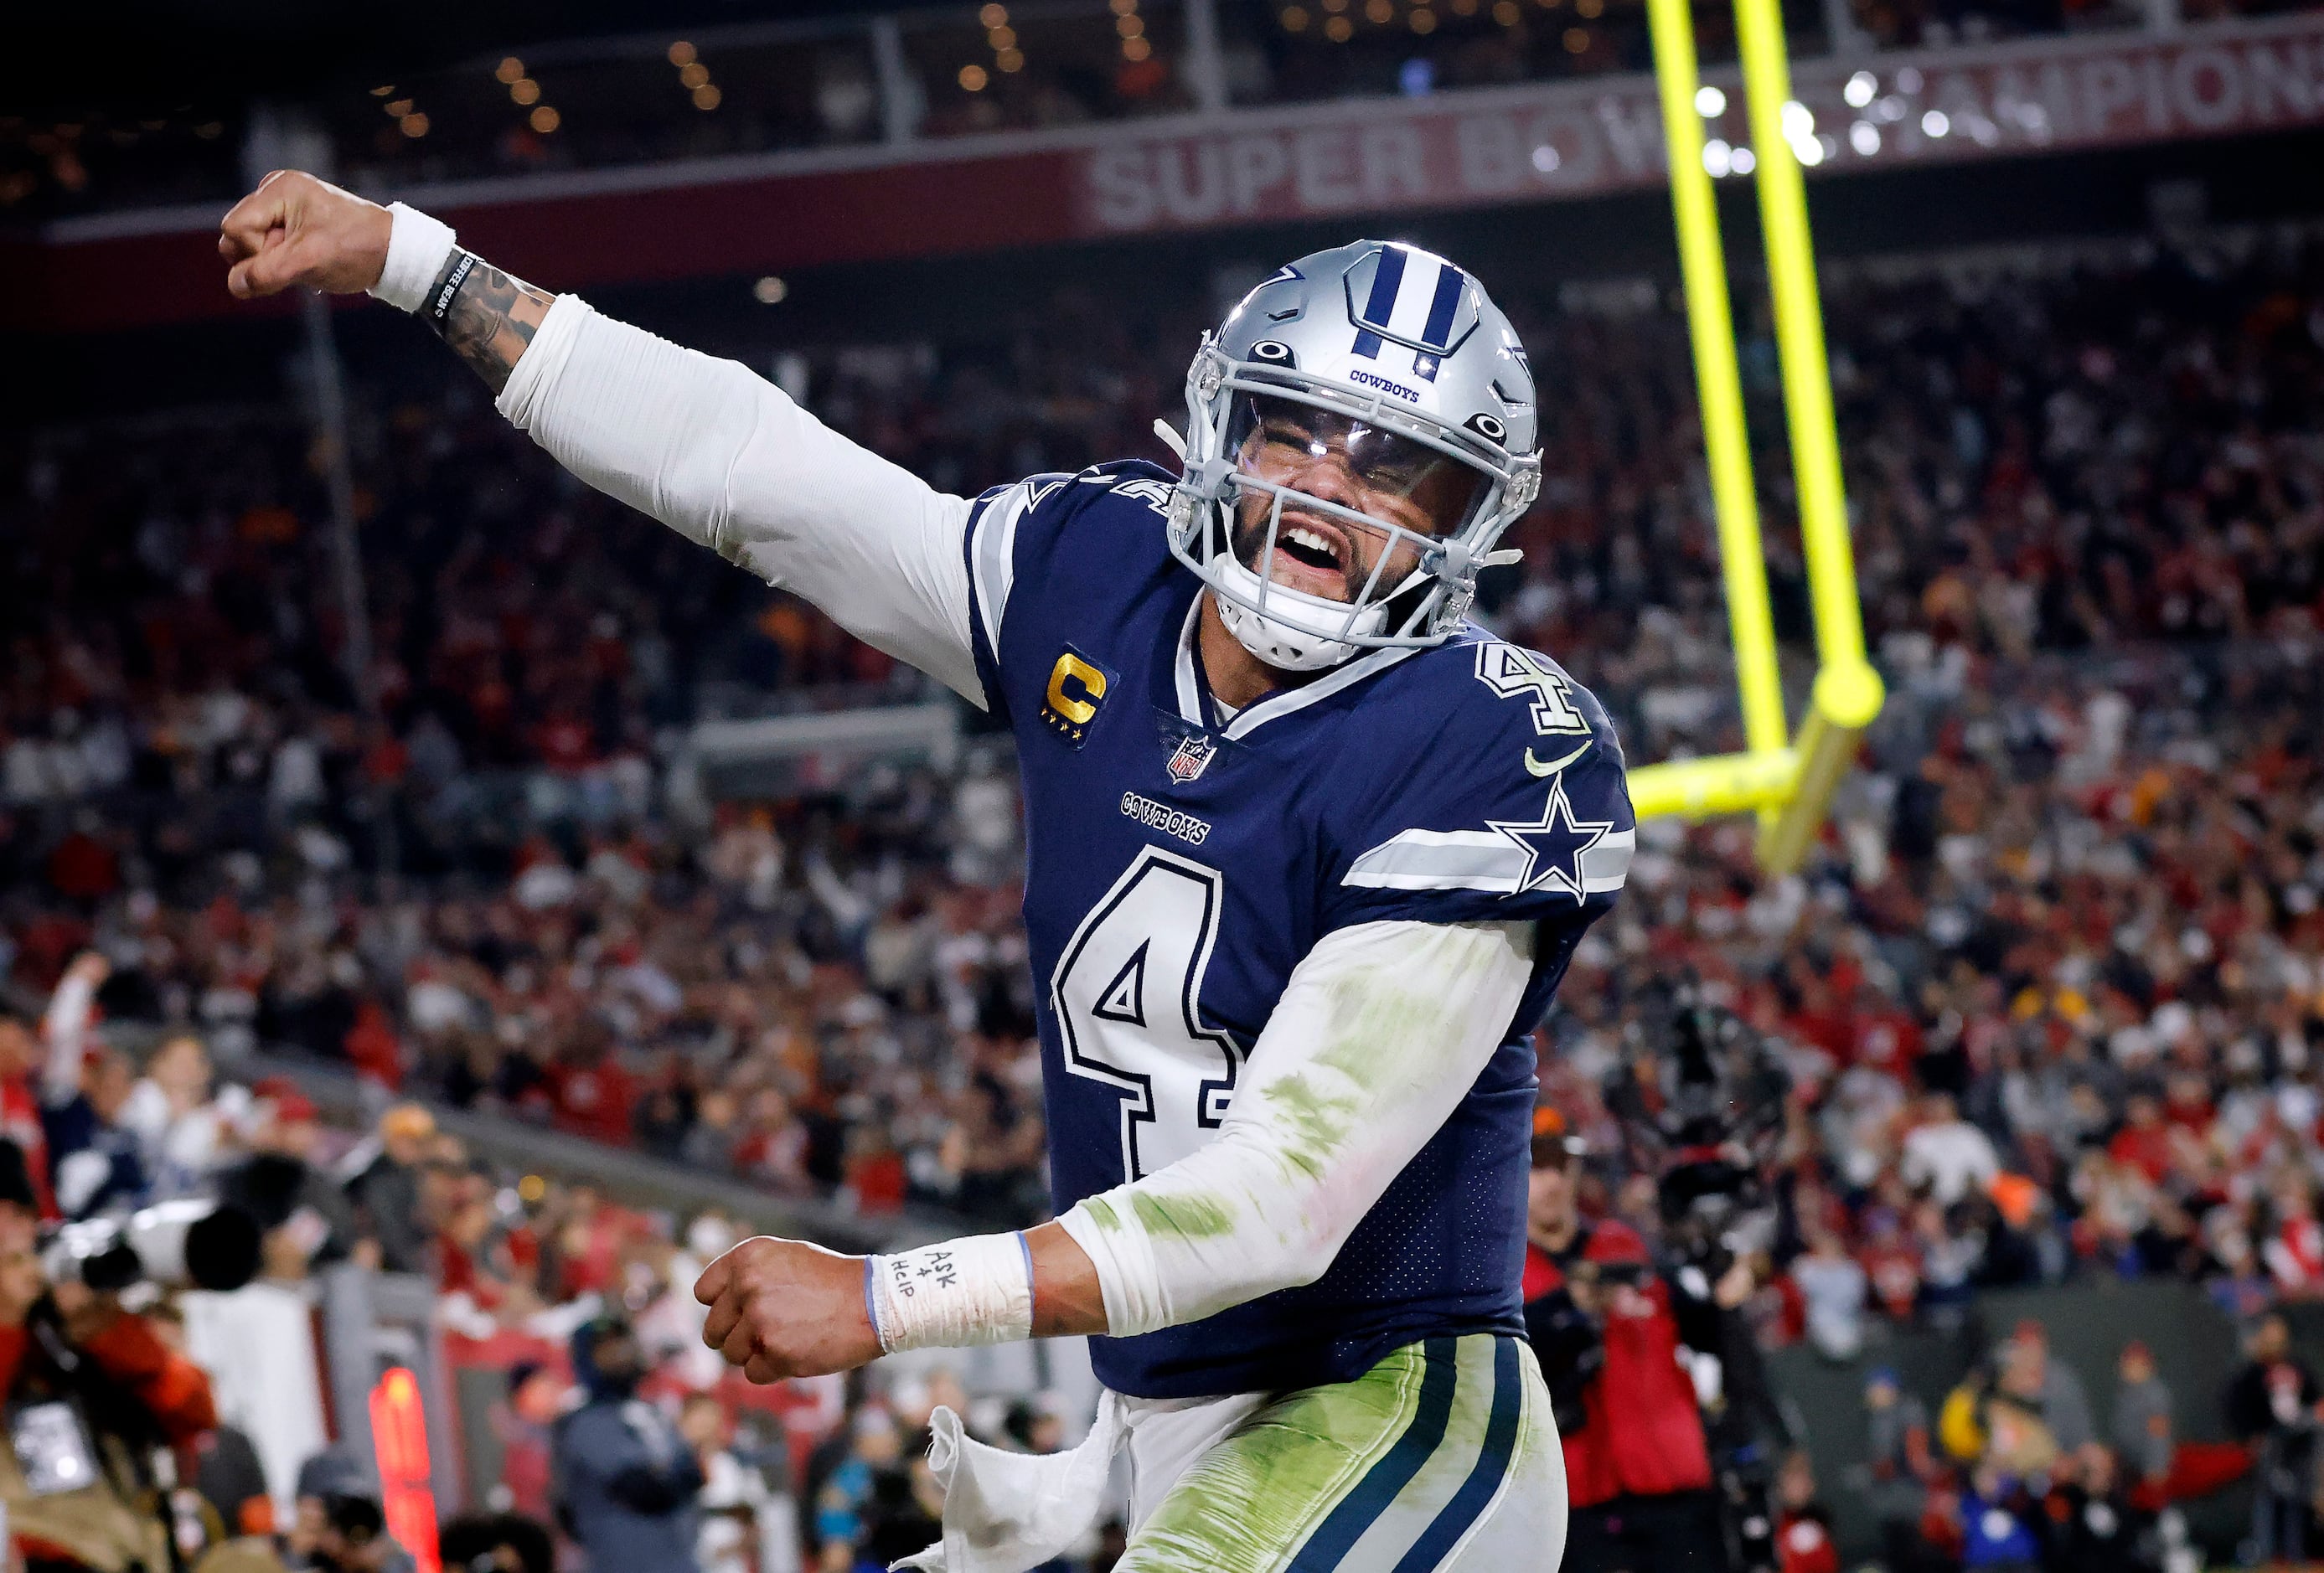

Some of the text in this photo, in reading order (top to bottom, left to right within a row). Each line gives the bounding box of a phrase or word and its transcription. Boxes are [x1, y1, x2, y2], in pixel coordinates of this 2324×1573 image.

[1088, 122, 1428, 229] SUPER
[1455, 96, 1729, 194] BOW
[436, 255, 473, 310] COFFEE BEAN
[1350, 370, 1420, 403] COWBOYS
[1046, 652, 1107, 725] C
[1474, 640, 1593, 736] 4
[1172, 753, 1200, 776] NFL
[1120, 792, 1211, 846] COWBOYS
[1051, 843, 1247, 1185] 4
[924, 1251, 957, 1288] ASK
